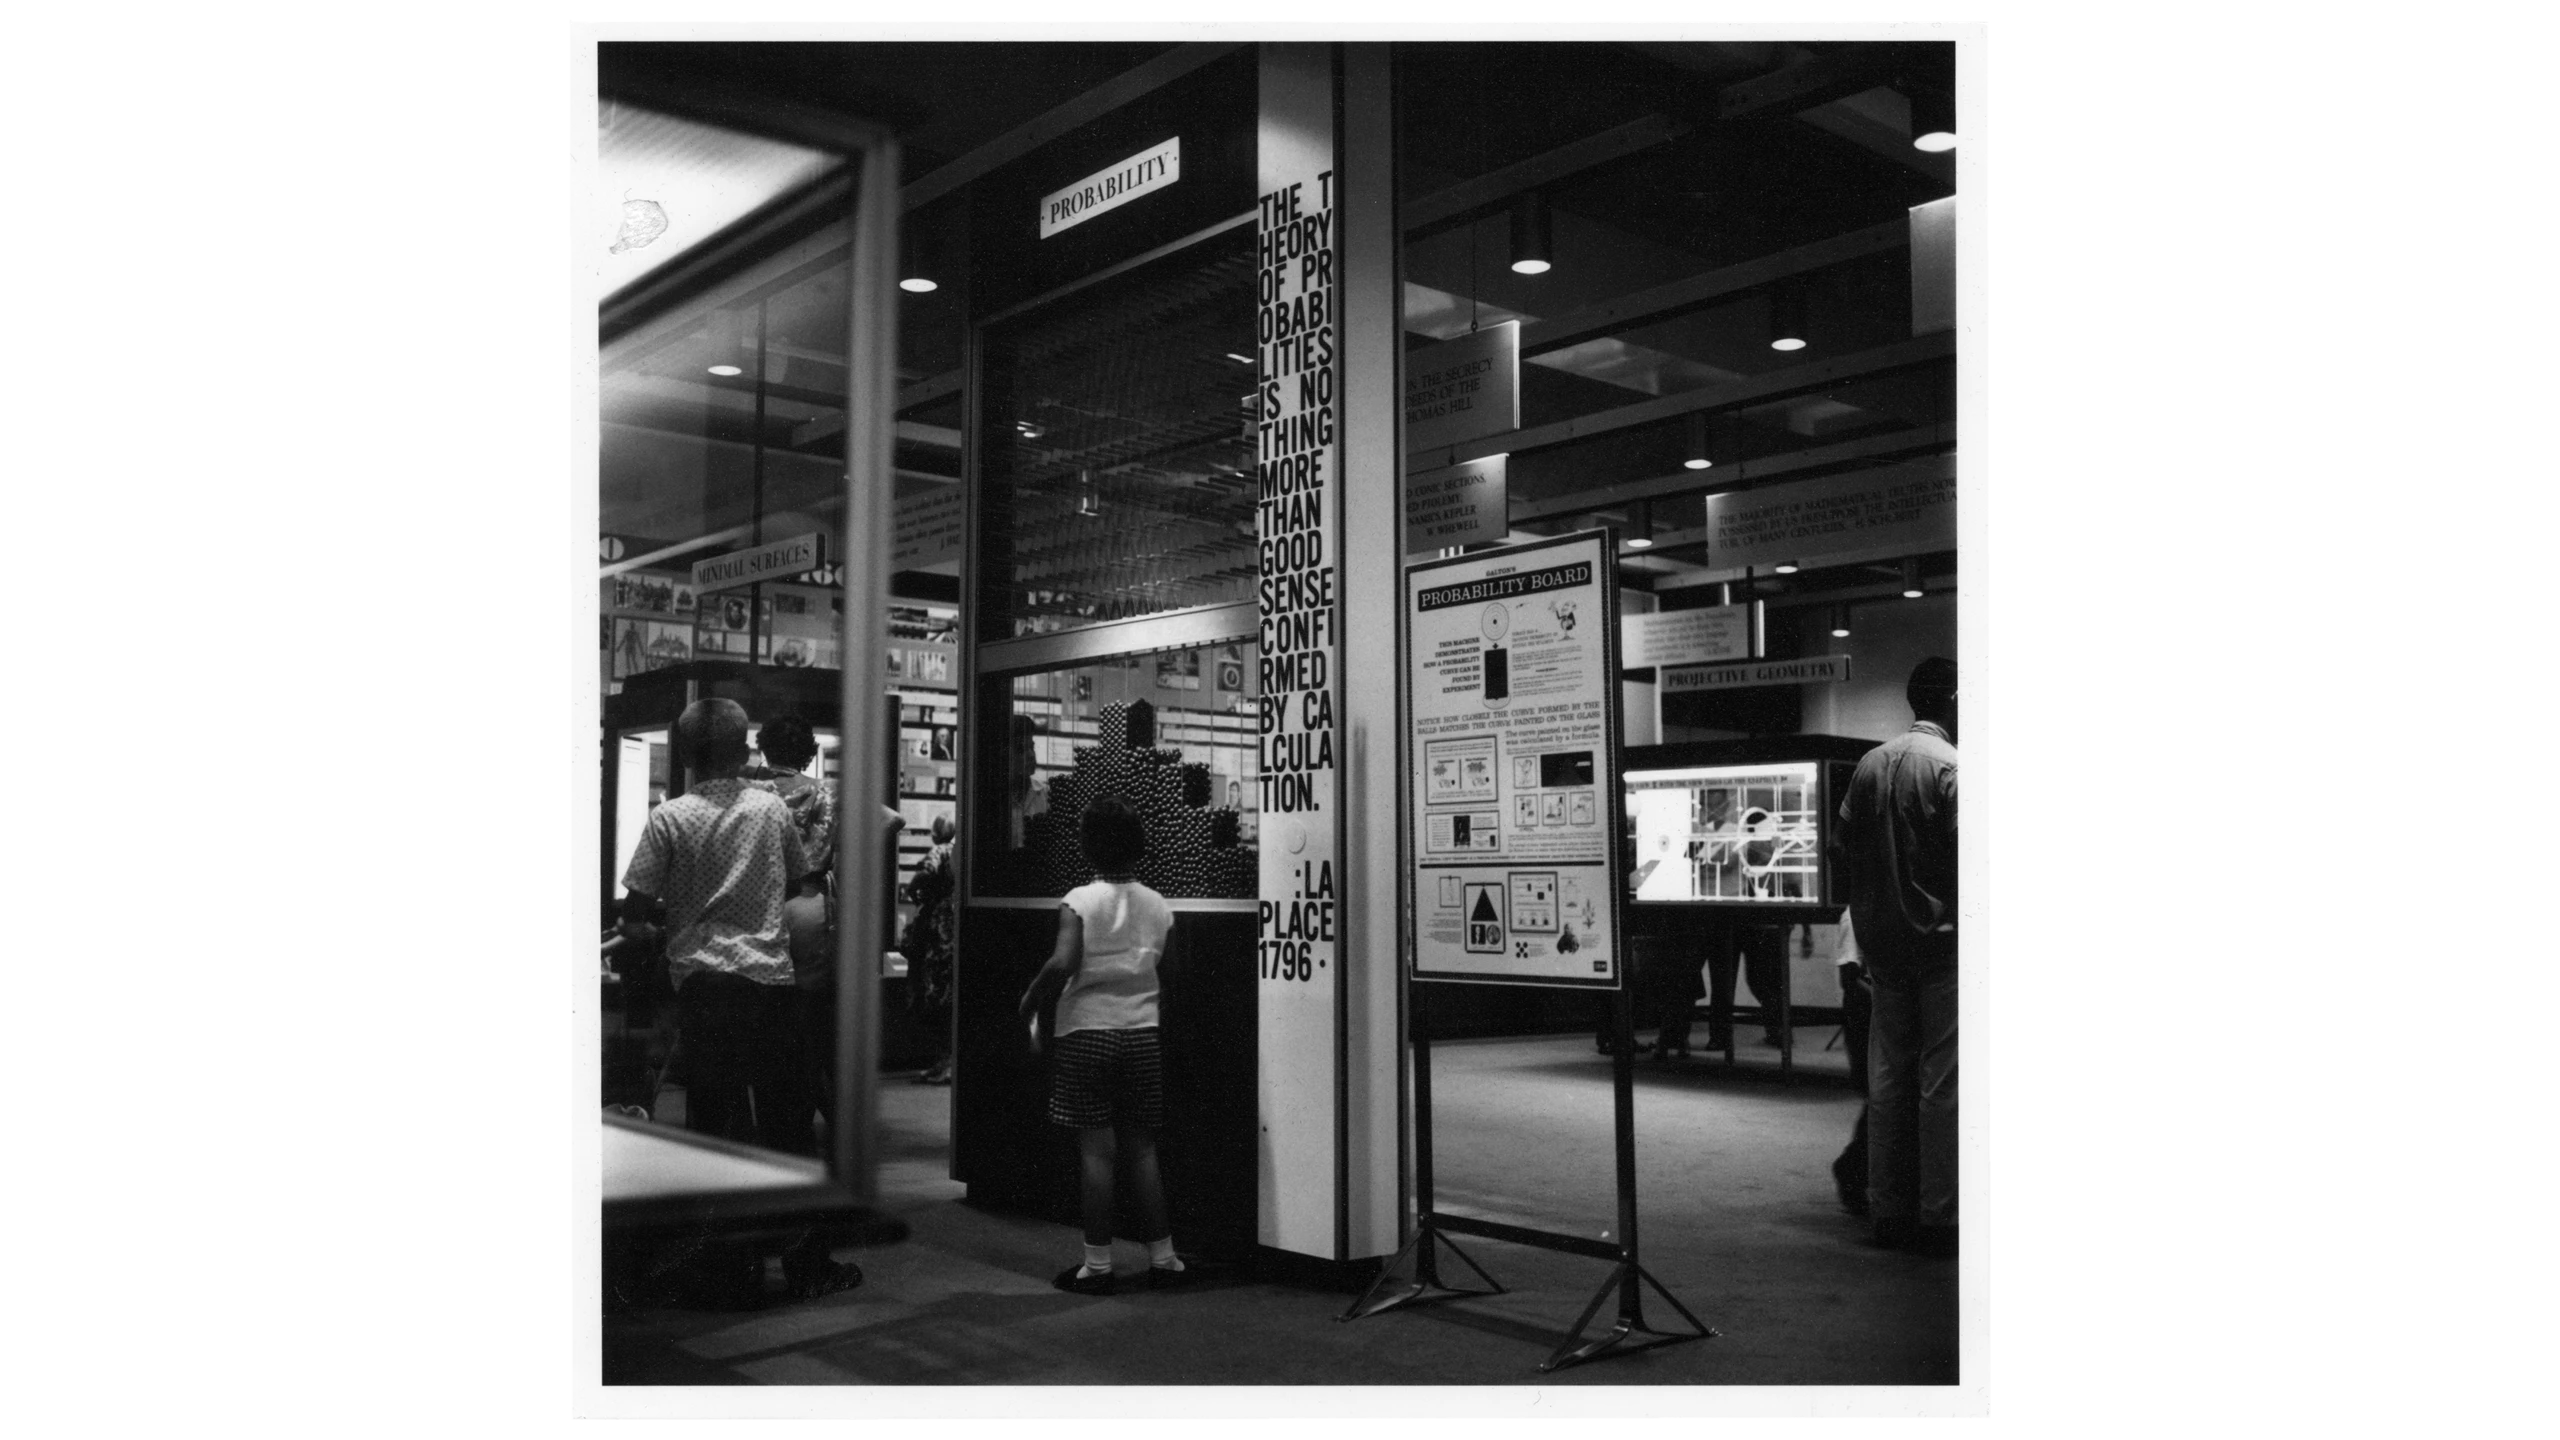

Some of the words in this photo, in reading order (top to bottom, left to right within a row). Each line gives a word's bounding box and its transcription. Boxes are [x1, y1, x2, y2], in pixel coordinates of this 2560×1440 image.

[1050, 151, 1170, 225] PROBABILITY
[1259, 182, 1302, 231] THE
[1318, 170, 1332, 209] T
[1259, 209, 1332, 270] HEORY
[1259, 263, 1286, 307] OF
[1301, 249, 1332, 293] PR
[1259, 286, 1332, 345] OBABI
[1259, 327, 1332, 383] LITIES
[1422, 372, 1441, 388] THE
[1445, 357, 1494, 381] SECRECY
[1260, 381, 1280, 422] IS
[1300, 366, 1332, 412] NO
[1440, 384, 1454, 399] OF
[1459, 378, 1480, 394] THE
[1450, 397, 1473, 414] HILL
[1259, 407, 1332, 461] THING
[1259, 449, 1324, 500] MORE
[1260, 490, 1322, 538] THAN
[1719, 515, 1735, 525] THE
[1866, 502, 1884, 514] THE
[1260, 530, 1322, 578] GOOD
[1743, 534, 1755, 546] OF
[698, 558, 745, 584] MINIMAL
[750, 542, 810, 574] SURFACES
[1260, 567, 1334, 616] SENSE
[1421, 578, 1526, 607] PROBABILITY
[1531, 566, 1588, 589] BOARD
[1260, 607, 1333, 656] CONFI
[1435, 646, 1480, 658] DEMONSTRATES
[1453, 637, 1480, 646] MACHINE
[1260, 650, 1326, 695] RMED
[1440, 668, 1458, 676] CURVE
[1442, 656, 1480, 666] PROBABILITY
[1668, 669, 1748, 686] PROJECTIVE
[1756, 662, 1835, 680] GEOMETRY
[1442, 684, 1480, 694] EXPERIMENT
[1260, 694, 1288, 734] BY
[1302, 690, 1333, 731] CA
[1417, 717, 1440, 726] NOTICE
[1444, 715, 1460, 723] HOW
[1461, 712, 1491, 722] CLOSELY
[1492, 710, 1508, 718] THE
[1511, 708, 1534, 716] CURVE
[1538, 704, 1569, 714] FORMED
[1584, 701, 1600, 709] THE
[1440, 724, 1470, 732] MATCHES
[1488, 720, 1511, 728] CURVE
[1514, 716, 1544, 726] PAINTED
[1559, 714, 1574, 722] THE
[1576, 711, 1600, 720] GLASS
[1260, 730, 1334, 773] LCULA
[1260, 772, 1320, 813] TION.
[1259, 900, 1334, 941] PLACE
[1259, 940, 1312, 982] 1796
